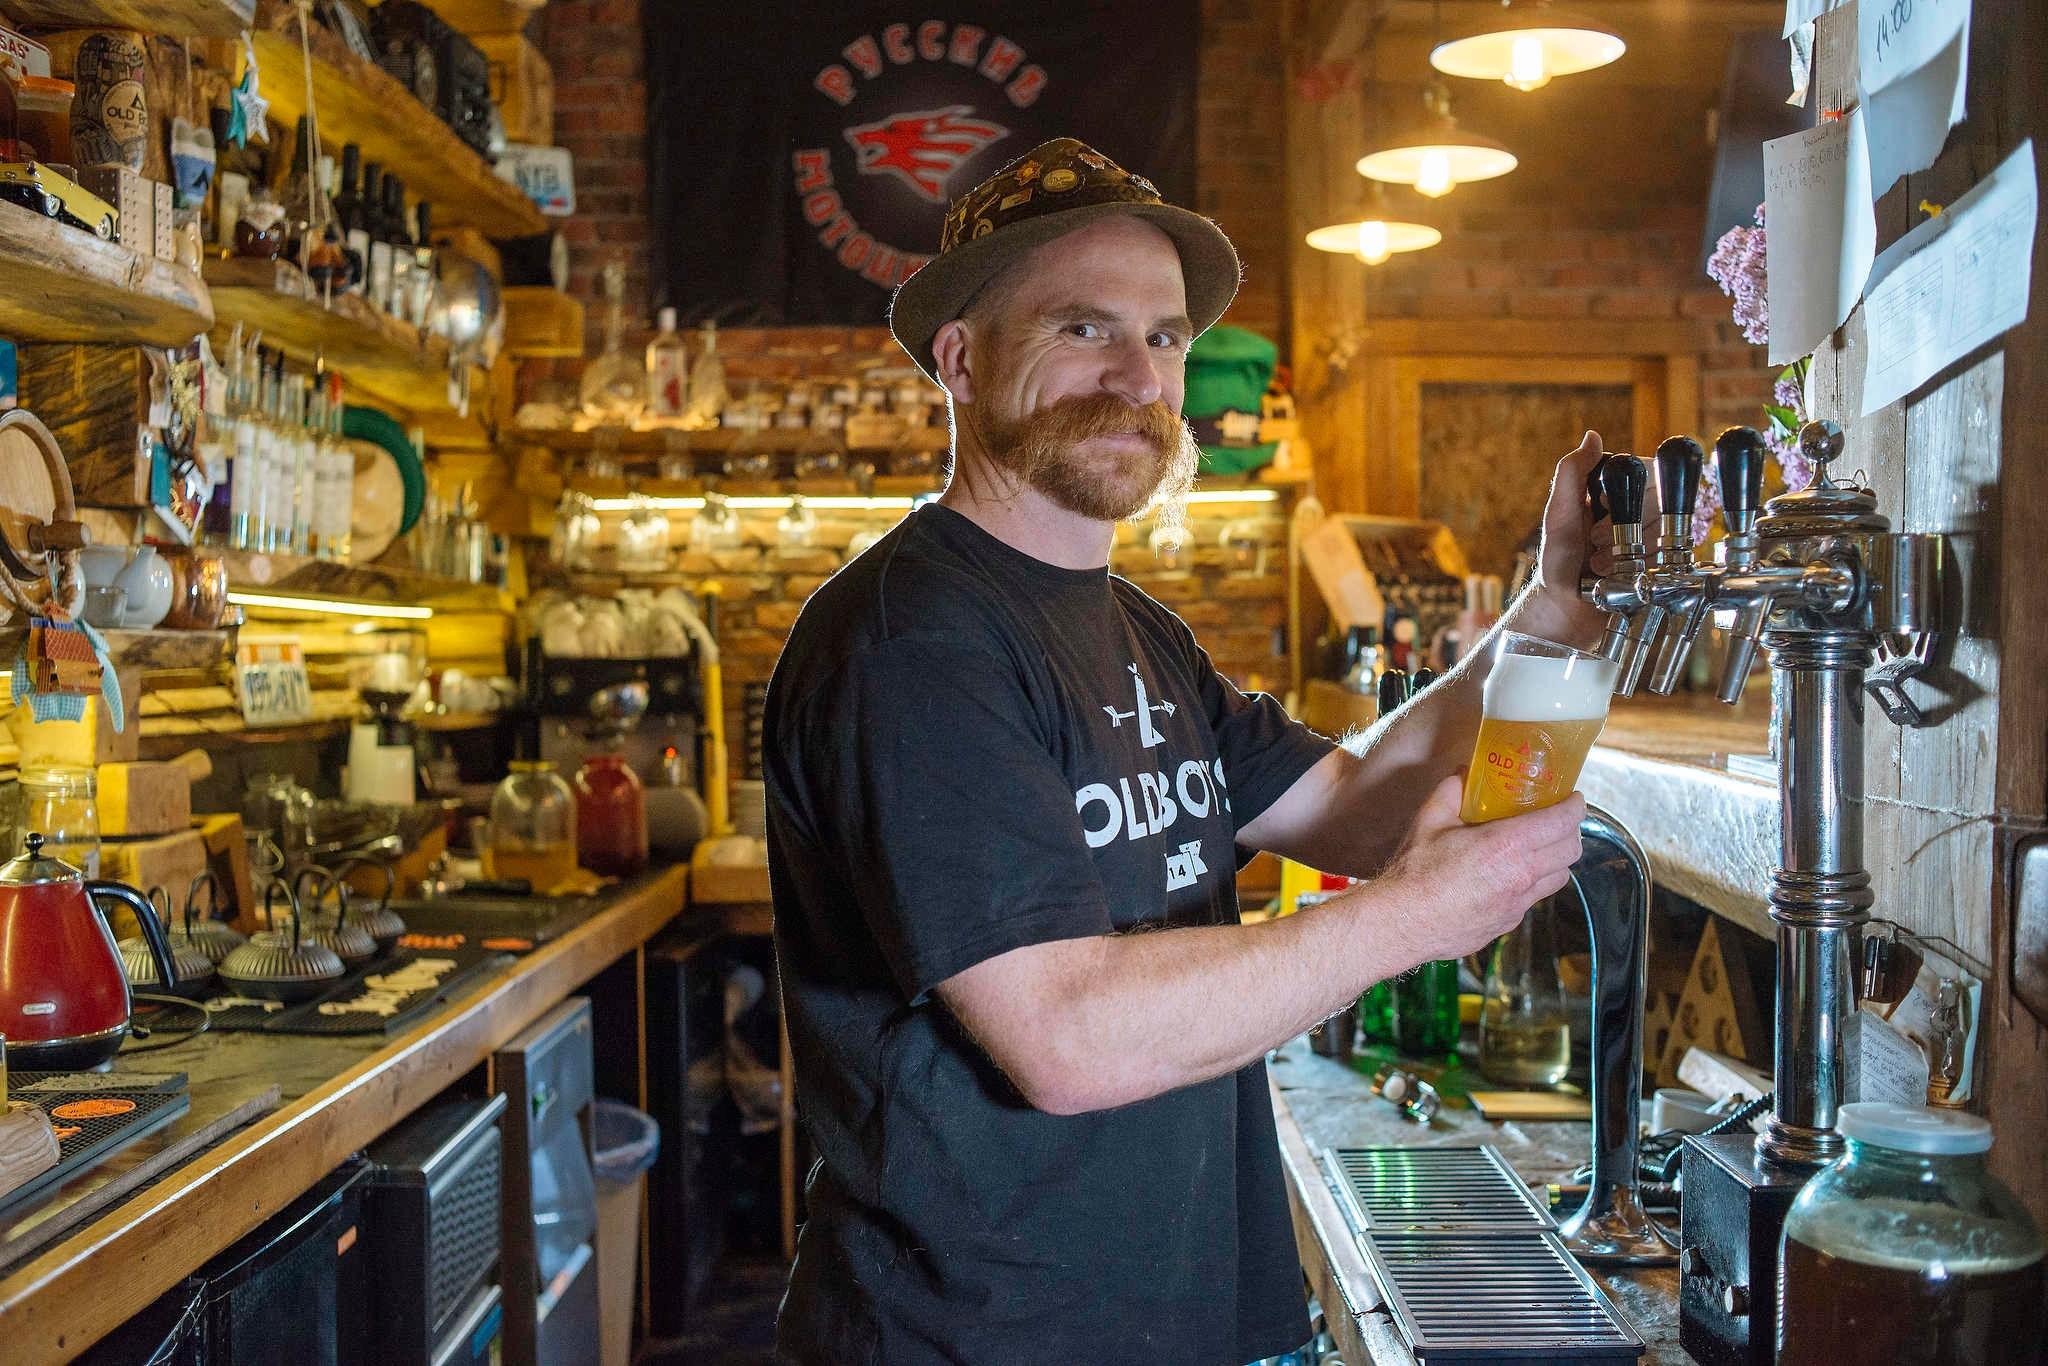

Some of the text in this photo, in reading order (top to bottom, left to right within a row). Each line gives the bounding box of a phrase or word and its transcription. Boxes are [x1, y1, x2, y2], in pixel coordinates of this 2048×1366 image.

[106, 106, 135, 121] OLD
[1487, 751, 1515, 770] OLD
[1168, 864, 1187, 880] 14
